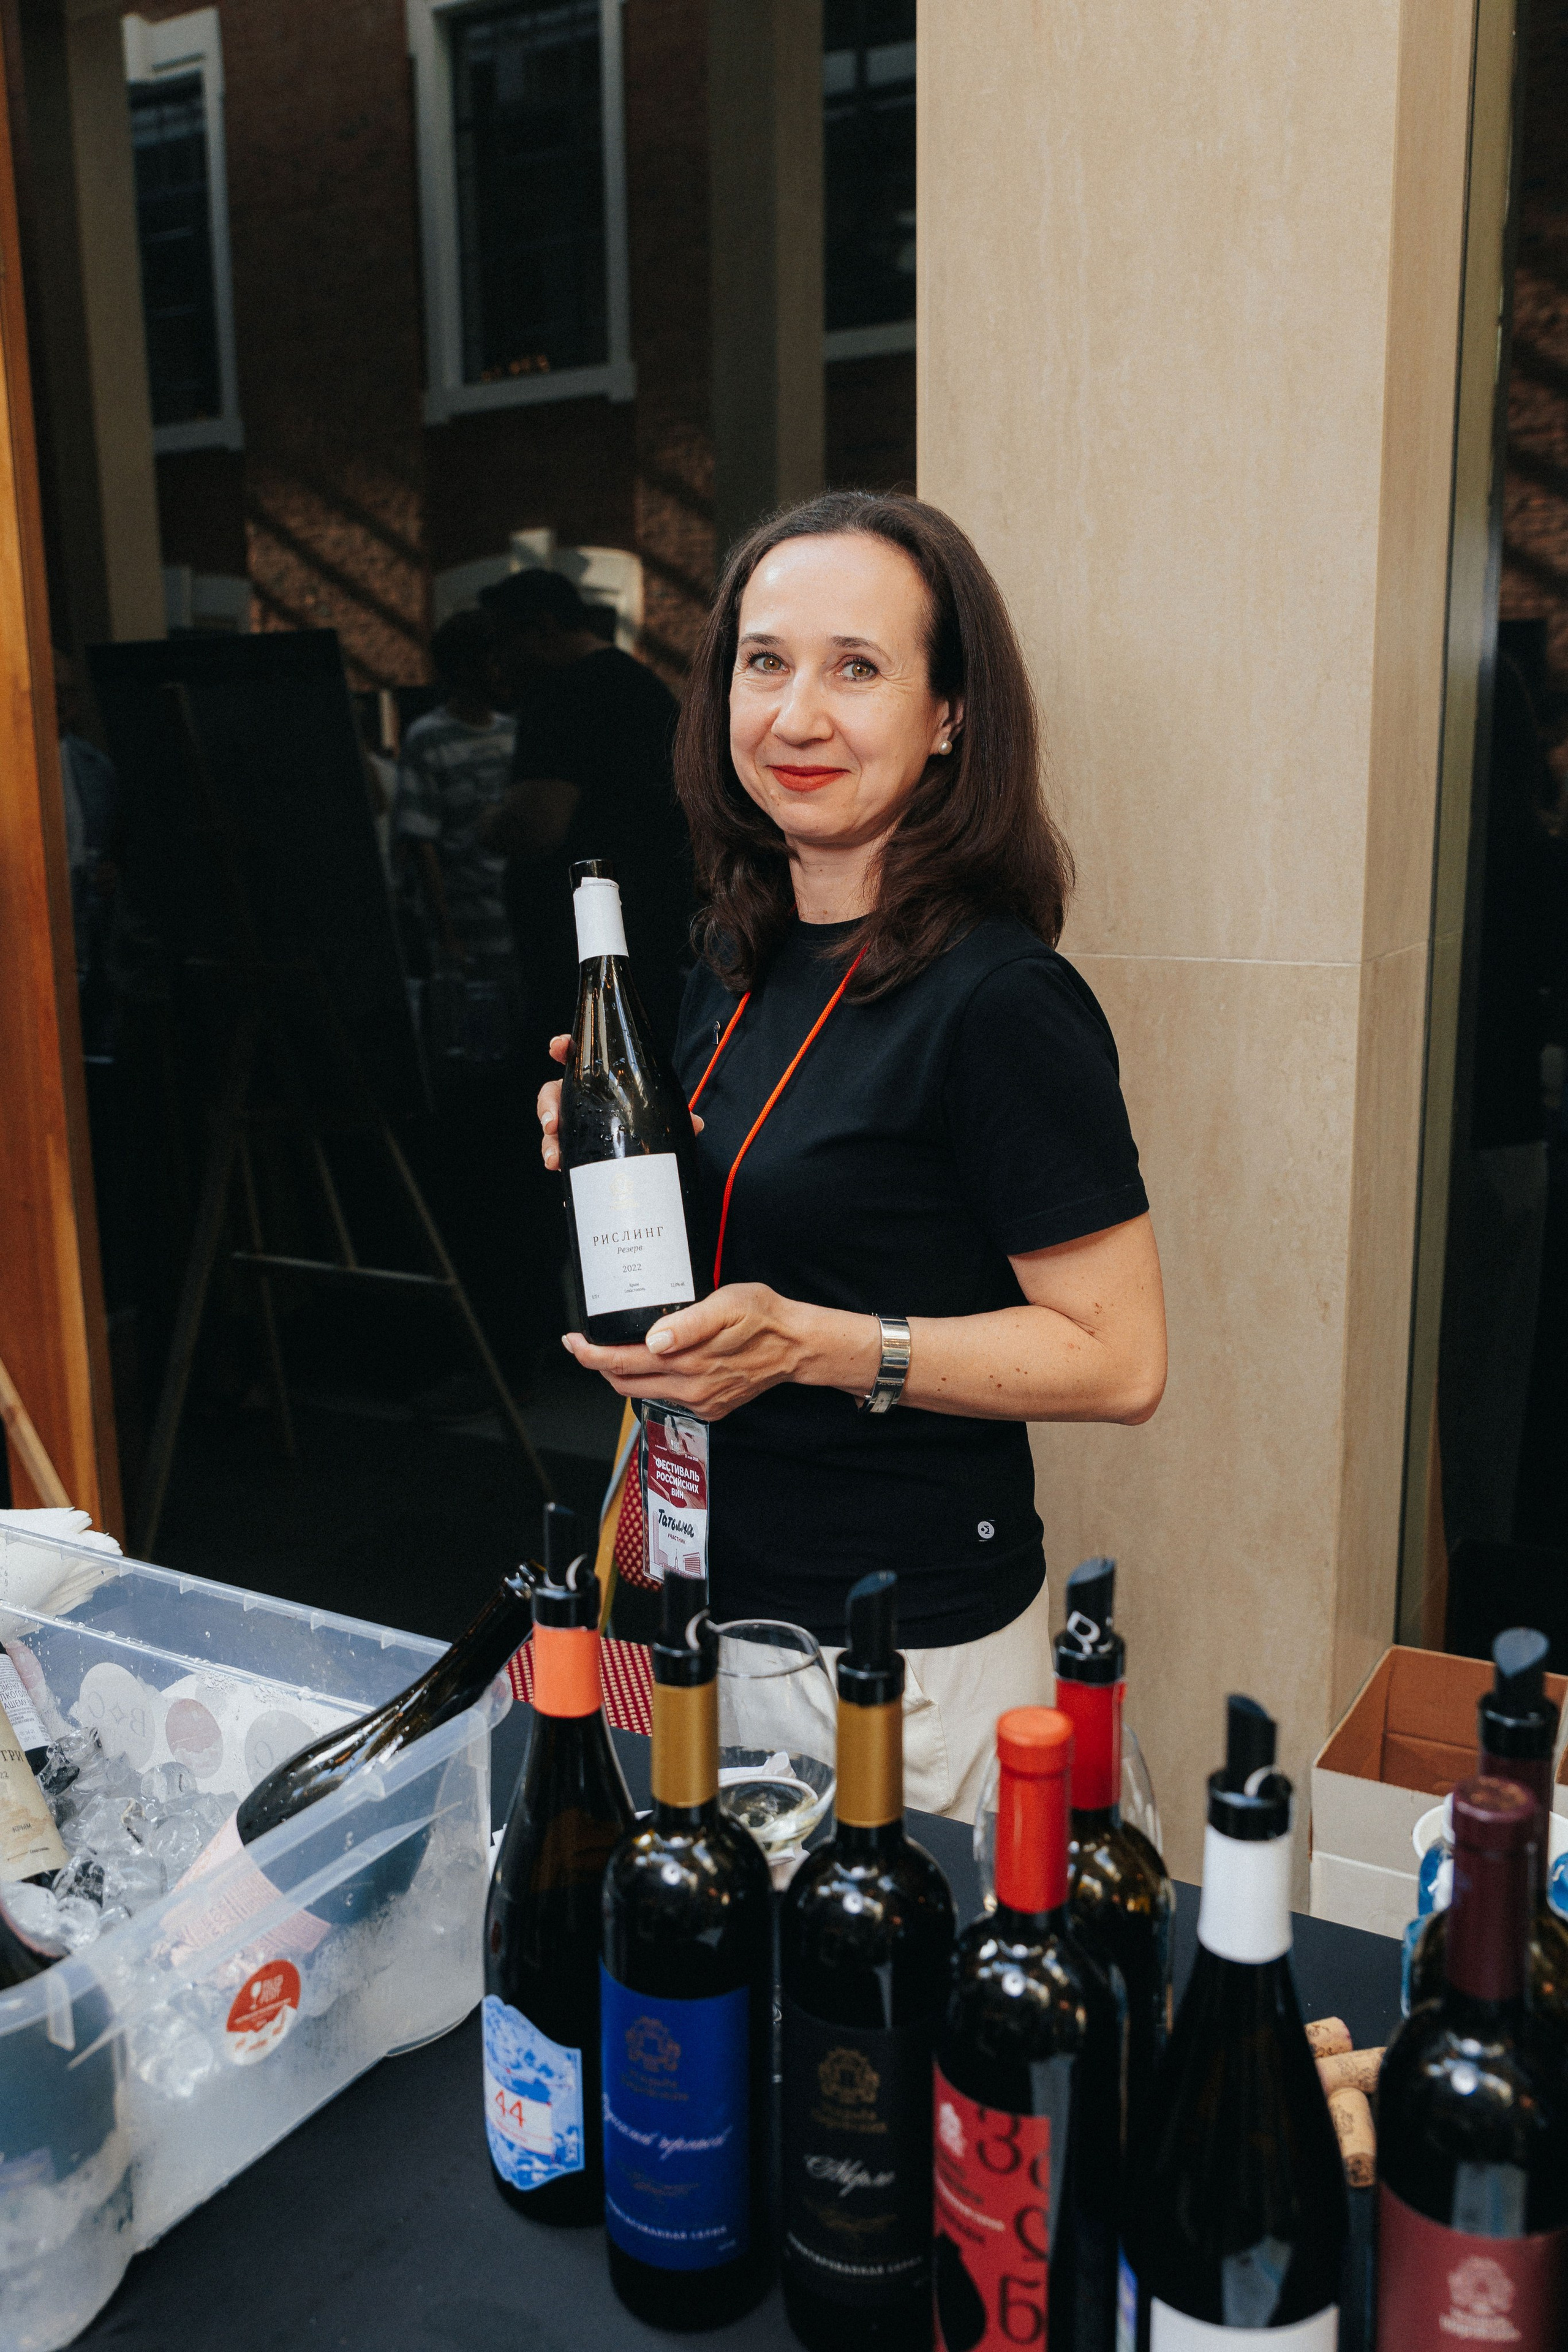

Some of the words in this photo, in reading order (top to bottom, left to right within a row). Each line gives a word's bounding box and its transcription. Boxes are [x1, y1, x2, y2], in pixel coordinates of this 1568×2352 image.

[593, 1226, 665, 1246] РИСЛИНГ
[617, 1245, 643, 1254] Резерв
[622, 1263, 642, 1273] 2022
[655, 1457, 700, 1482] ФЕСТИВАЛЬ
[656, 1470, 699, 1494] РОССИЙСКИХ
[671, 1487, 684, 1499] ВИН
[658, 1509, 695, 1538] Татьяна
[667, 1532, 686, 1545] УЧАСТНИК
[12, 1823, 32, 1833] КРЫМ
